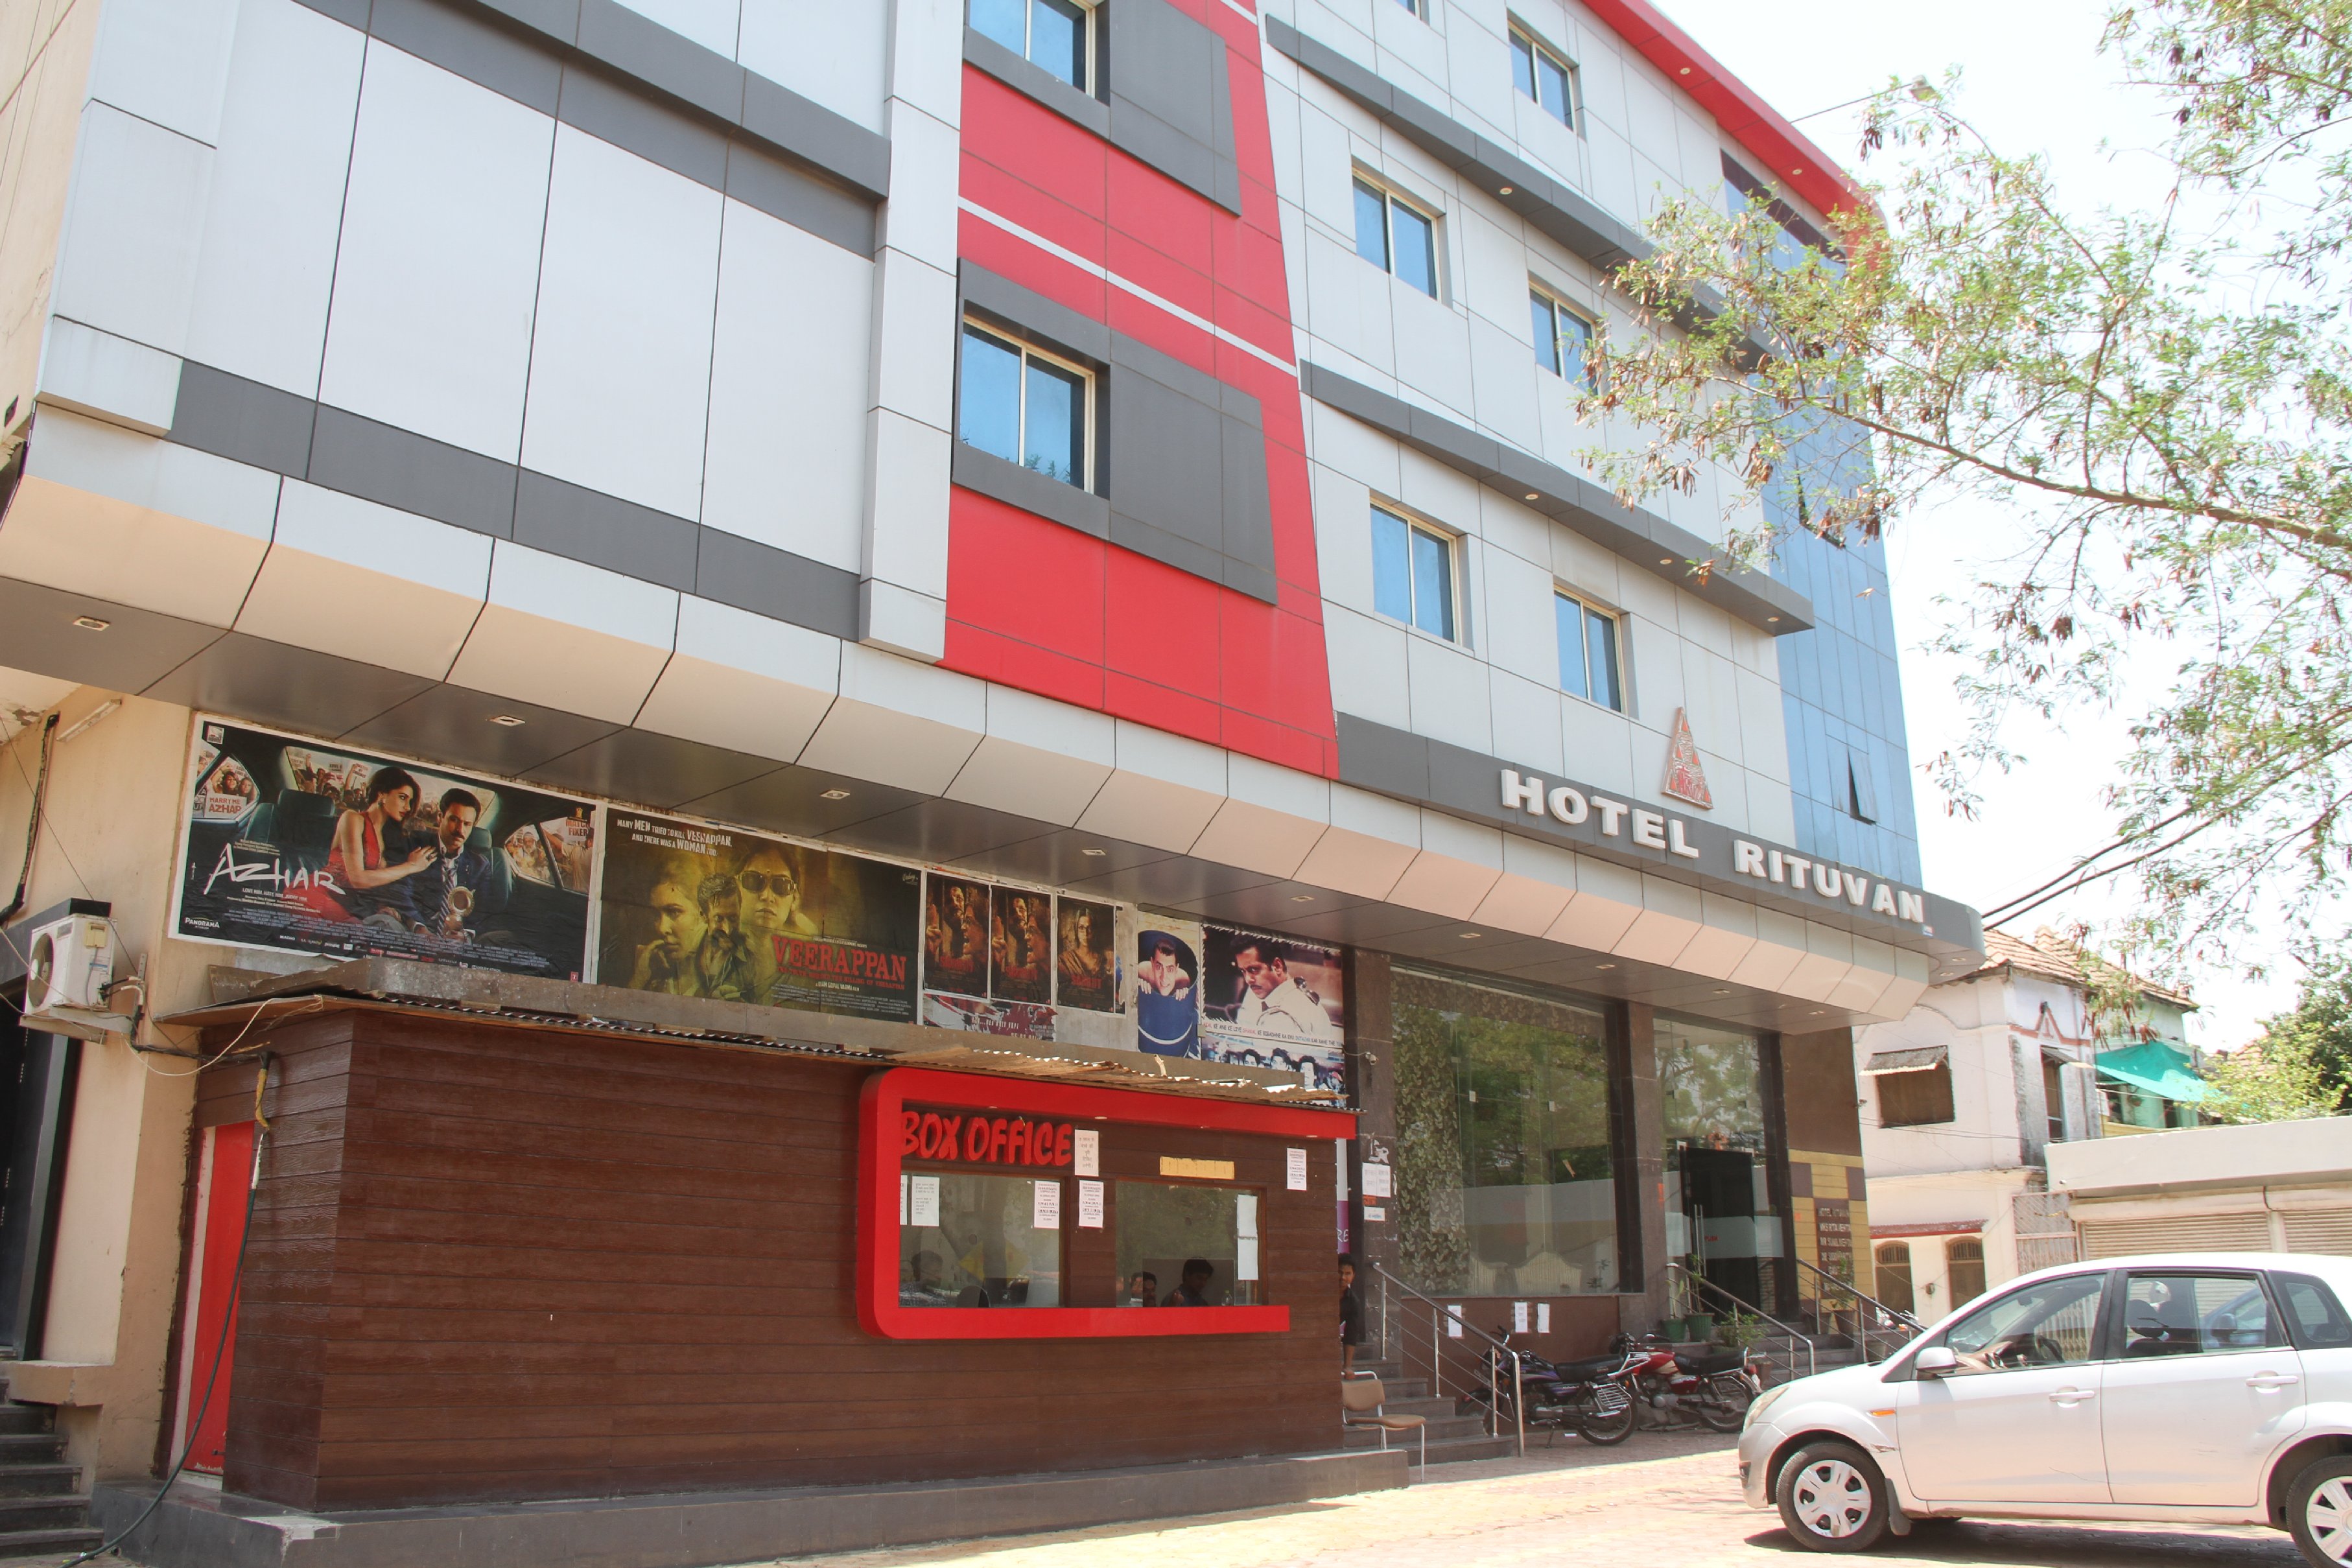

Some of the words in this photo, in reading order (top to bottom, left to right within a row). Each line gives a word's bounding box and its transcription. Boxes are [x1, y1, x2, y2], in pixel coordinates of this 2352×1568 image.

[568, 828, 589, 836] FIXER
[617, 819, 633, 829] MANY
[634, 819, 651, 832] MEN
[652, 825, 666, 836] TRIED
[674, 830, 685, 839] KILL
[631, 833, 643, 841] AND
[644, 835, 659, 845] THERE
[660, 838, 672, 847] WAS
[677, 839, 706, 854] WOMAN
[1501, 769, 1699, 858] HOTEL
[1734, 839, 1923, 924] RITUVAN
[204, 843, 346, 895] AZHAR
[185, 917, 220, 929] PANORAMA
[770, 934, 906, 983] VEERAPPAN
[901, 1111, 961, 1160] BOX
[965, 1116, 1074, 1167] OFFICE
